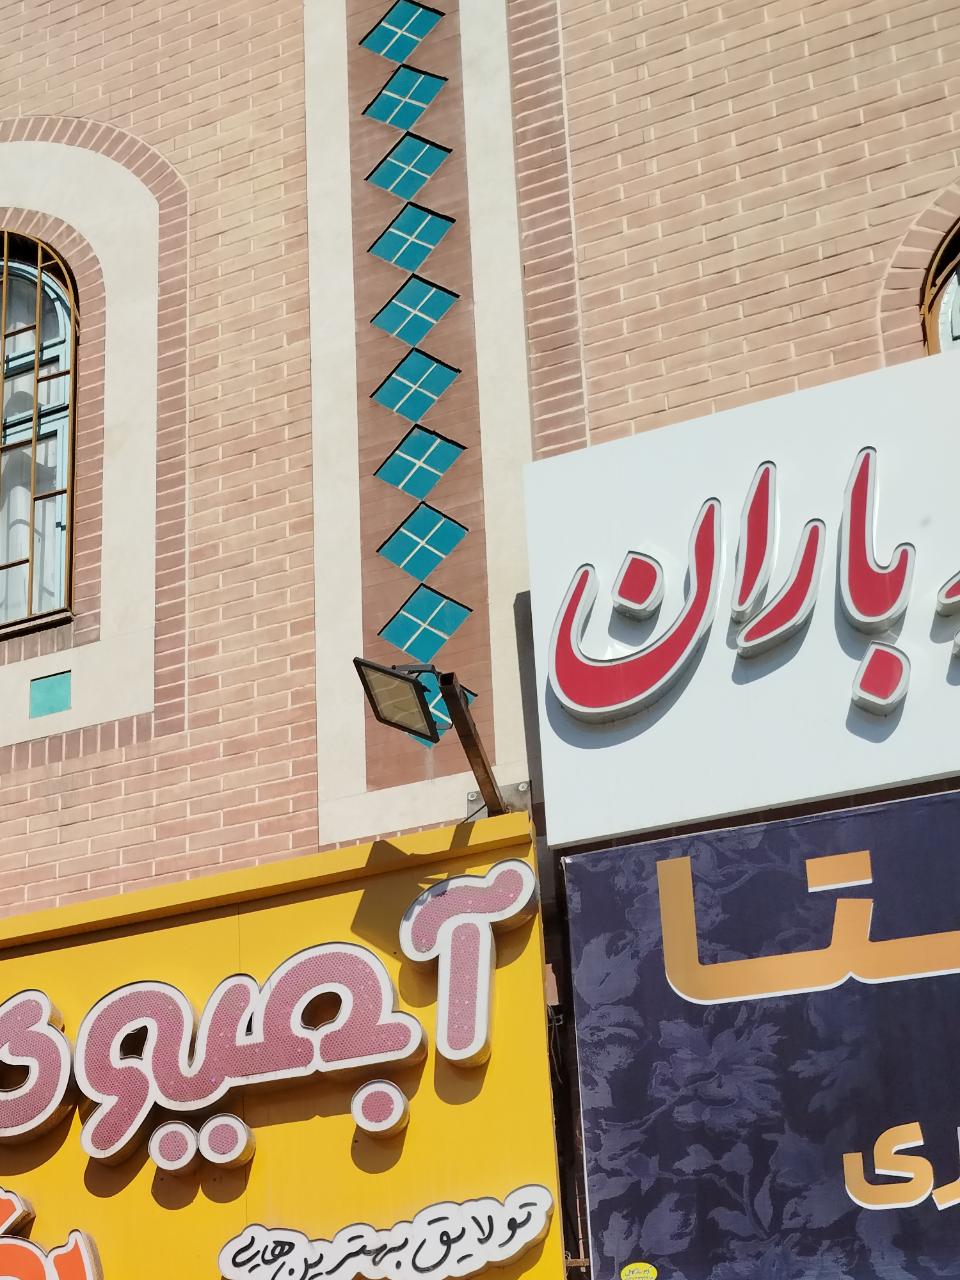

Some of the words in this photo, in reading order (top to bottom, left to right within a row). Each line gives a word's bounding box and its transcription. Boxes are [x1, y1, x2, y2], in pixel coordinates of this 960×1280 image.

[548, 447, 917, 718] باران
[412, 1215, 494, 1274] لایق
[498, 1202, 538, 1248] تو
